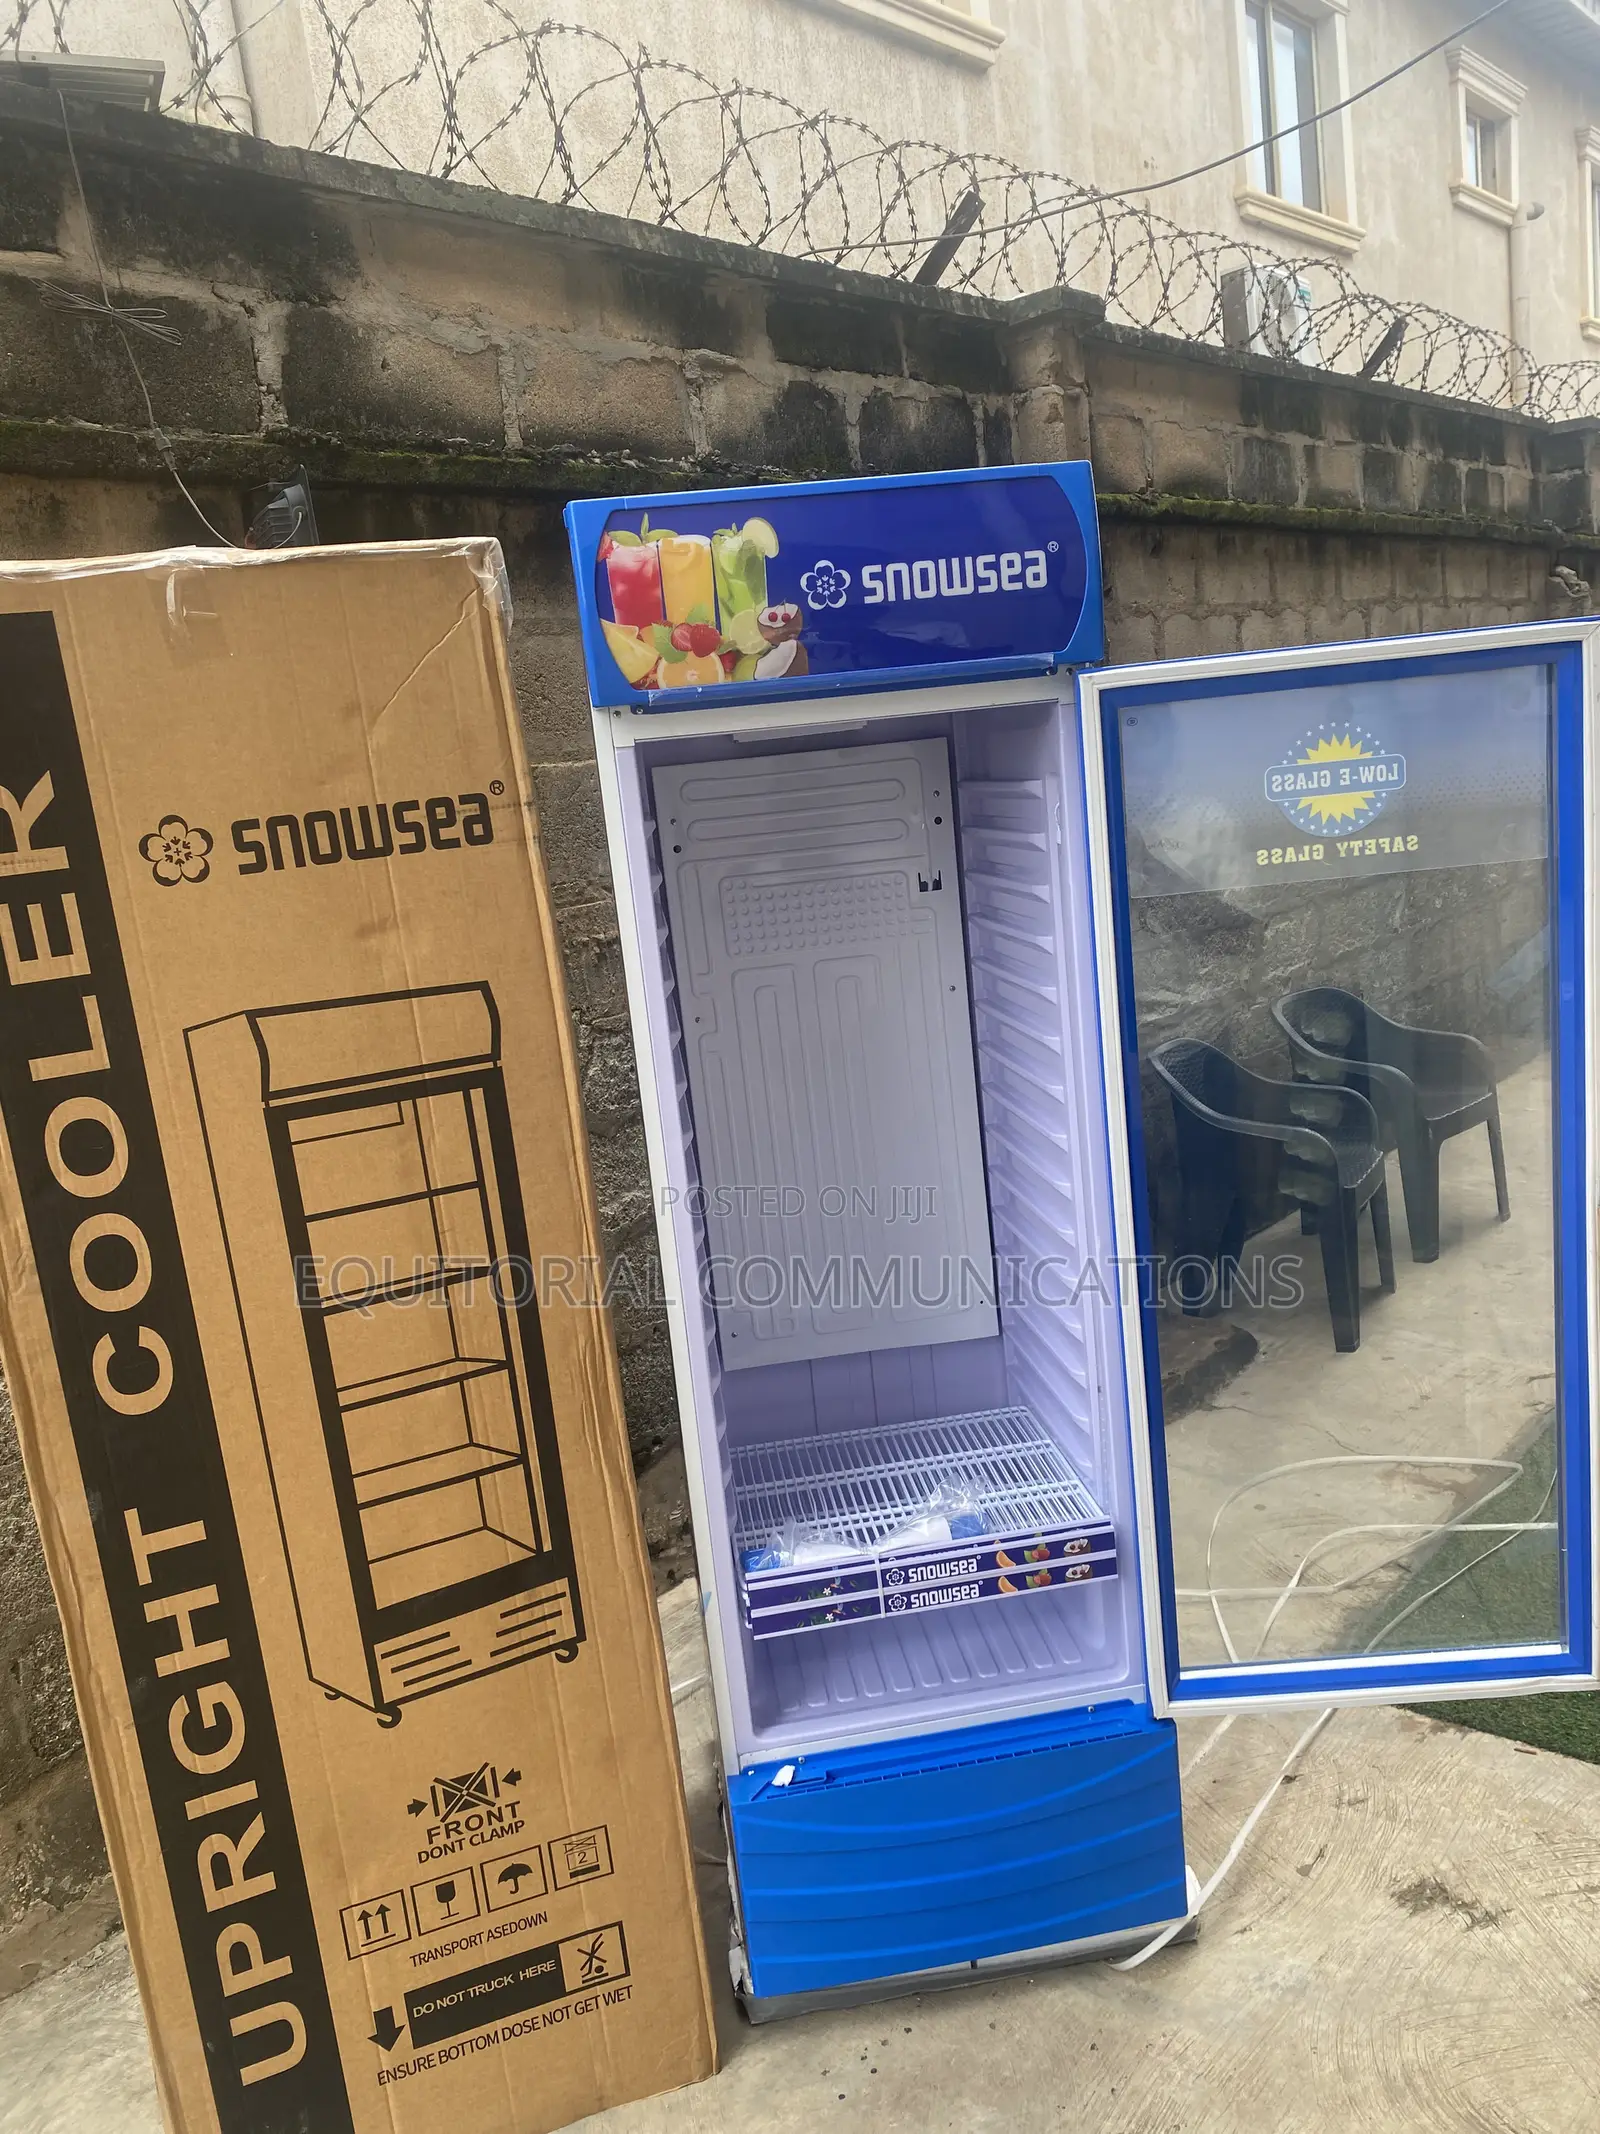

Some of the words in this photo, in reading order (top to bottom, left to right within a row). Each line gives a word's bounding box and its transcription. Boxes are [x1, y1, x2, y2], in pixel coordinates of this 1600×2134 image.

[0, 770, 174, 1417] COOLER
[123, 1508, 308, 2087] UPRIGHT
[426, 1801, 521, 1845] FRONT
[418, 1838, 466, 1864] DONT
[469, 1820, 525, 1847] CLAMP
[577, 1851, 588, 1864] 2
[409, 1931, 484, 1968] TRANSPORT
[486, 1911, 548, 1943] ASEDOWN
[413, 2002, 435, 2018] DO
[436, 1991, 466, 2011] NOT
[467, 1974, 515, 1998] TRUCK
[519, 1959, 557, 1981] HERE
[377, 2053, 437, 2086] ENSURE
[438, 2030, 500, 2065] BOTTOM
[501, 2016, 541, 2042] DOSE
[542, 2004, 572, 2028] NOT
[574, 1995, 601, 2016] GET
[602, 1985, 634, 2008] WET
